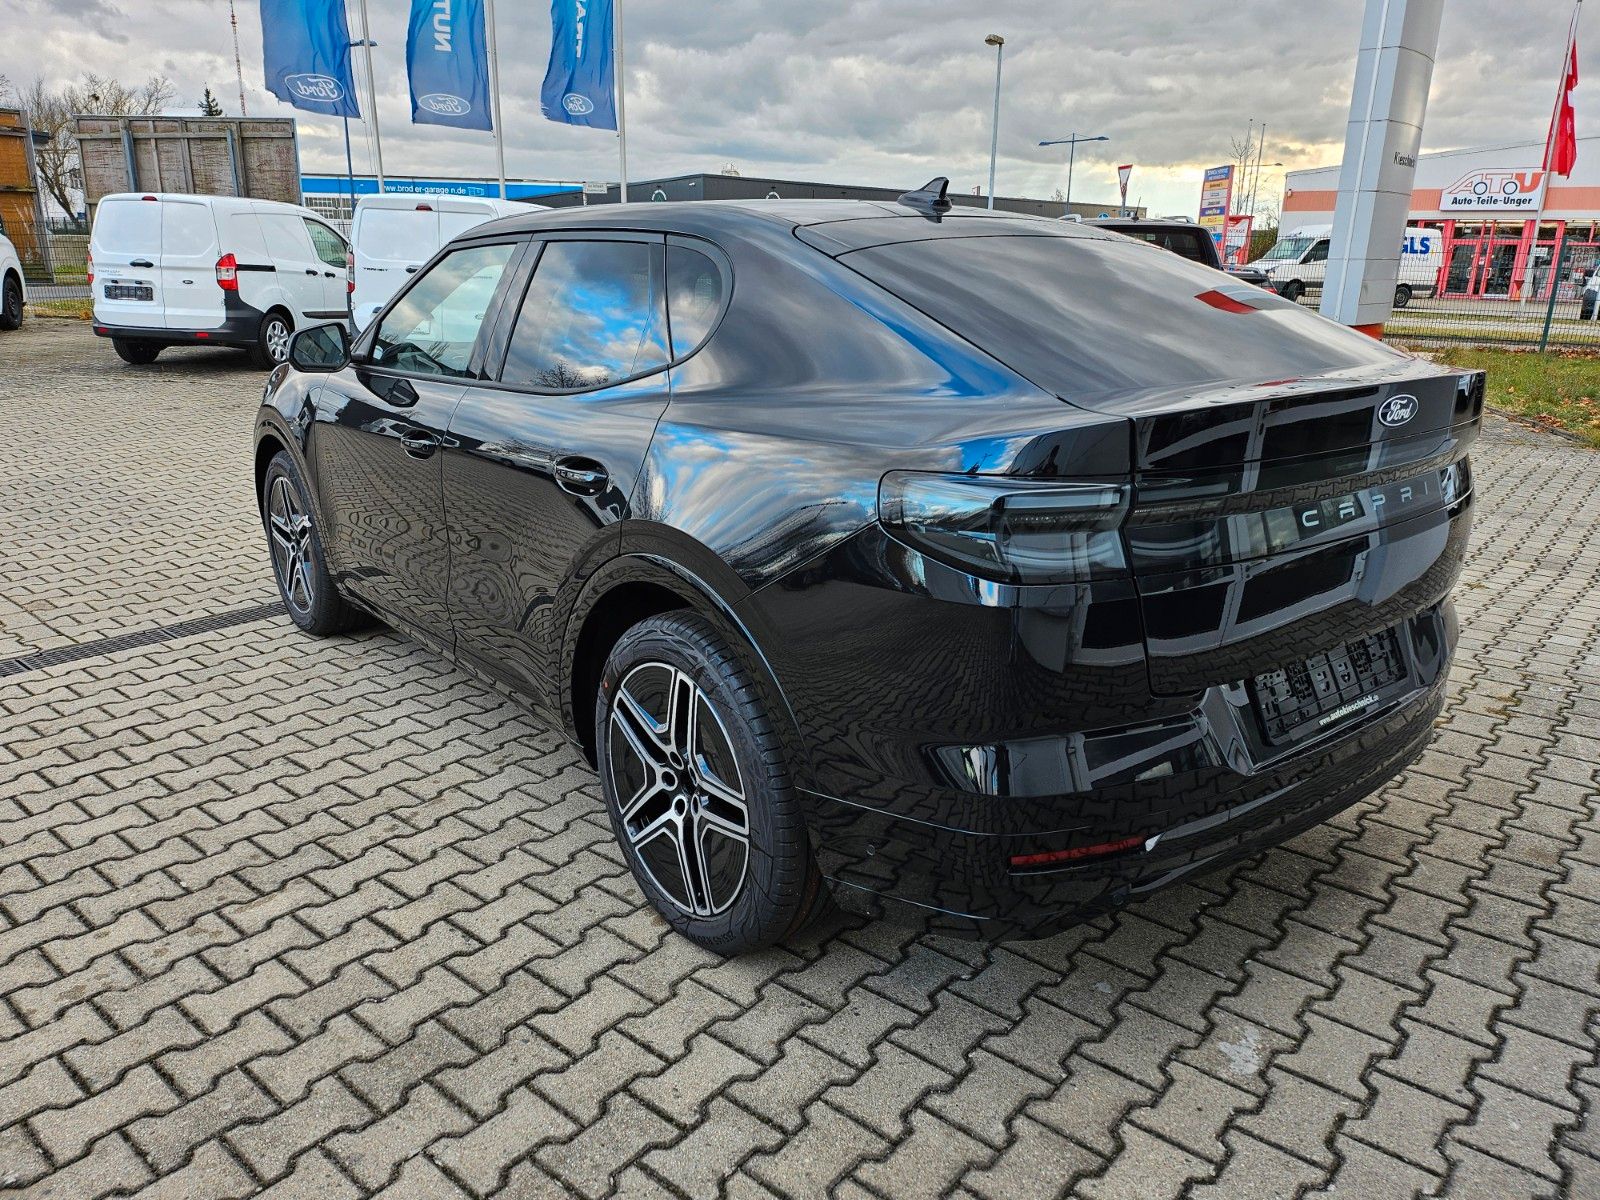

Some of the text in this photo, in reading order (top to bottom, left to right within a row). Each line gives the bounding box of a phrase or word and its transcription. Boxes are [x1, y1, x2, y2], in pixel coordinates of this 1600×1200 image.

[1451, 196, 1533, 207] Auto-Teile-Unger
[1386, 398, 1414, 422] Ford
[1301, 481, 1429, 528] CAPRI
